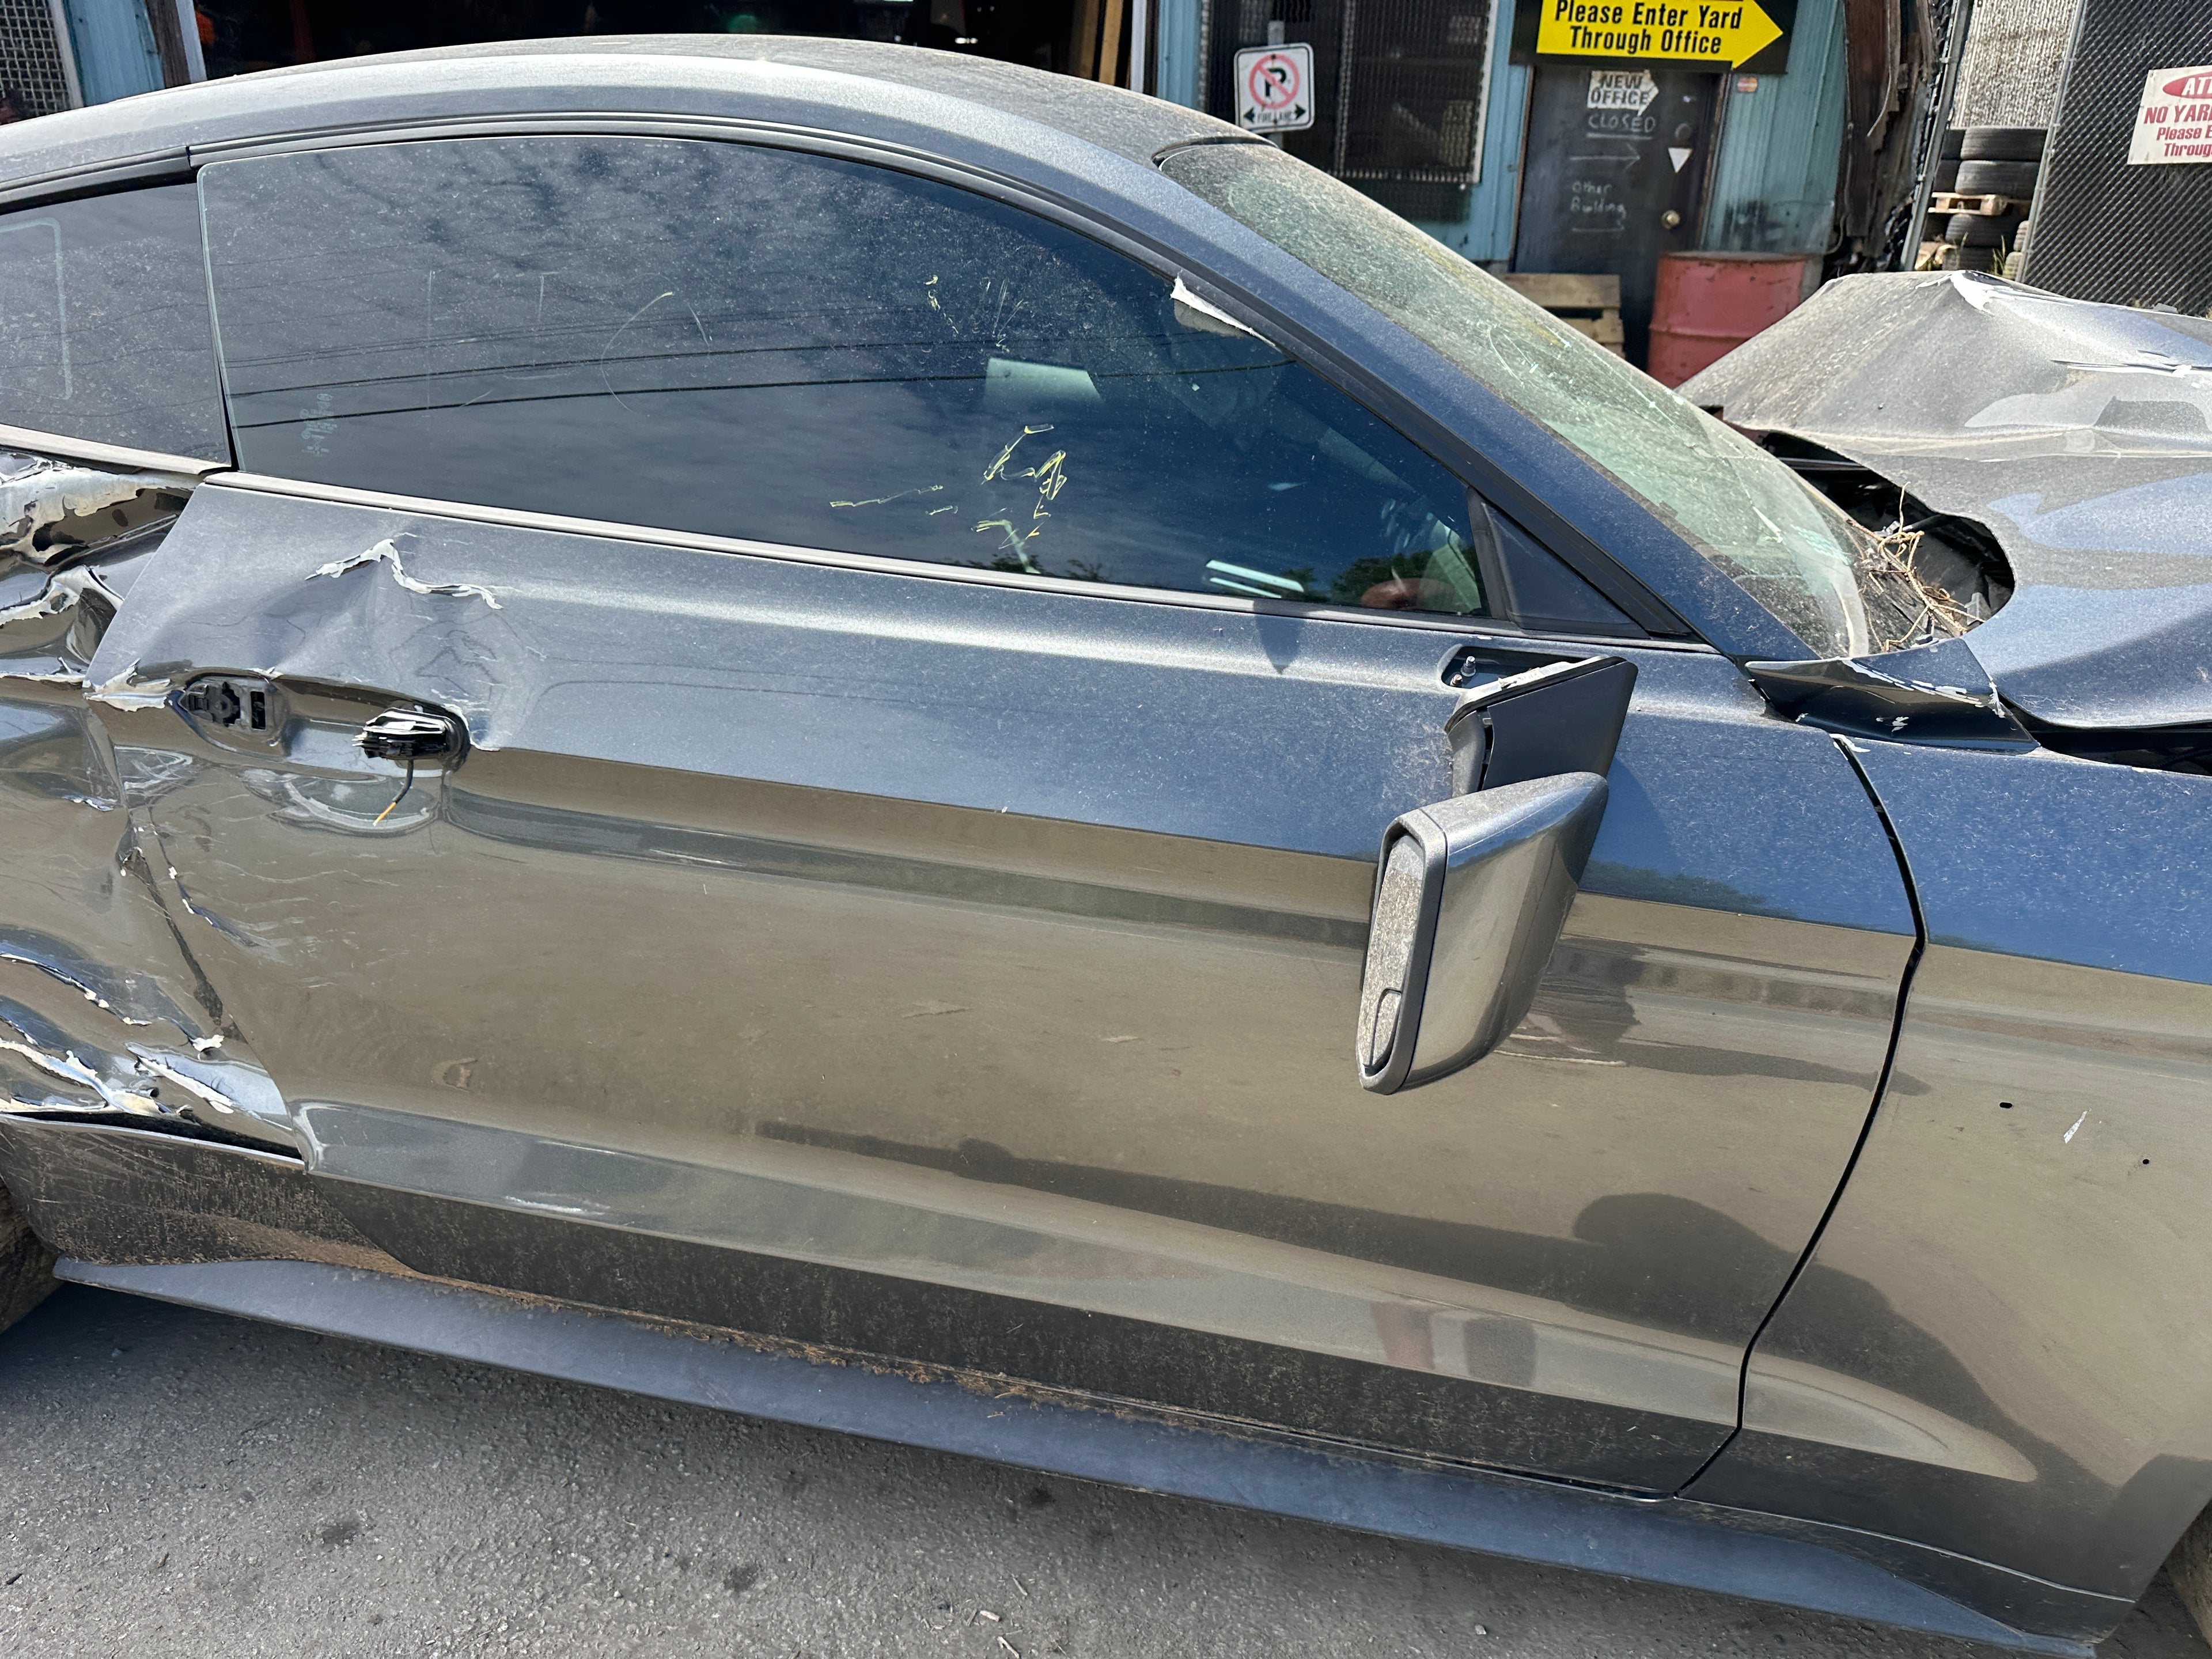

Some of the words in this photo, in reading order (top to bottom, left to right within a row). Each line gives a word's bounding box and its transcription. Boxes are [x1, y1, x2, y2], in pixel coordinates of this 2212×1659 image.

[1554, 0, 1623, 24] Please
[1633, 2, 1688, 26] Enter
[1698, 5, 1743, 29] Yard
[1570, 25, 1652, 54] Through
[1660, 29, 1722, 54] Office
[1599, 74, 1644, 89] NEW
[1590, 86, 1649, 105] OFFICE
[1588, 113, 1656, 133] CLOSED
[2143, 106, 2169, 124] NO
[2156, 127, 2202, 141] Please
[2164, 143, 2212, 158] Throug
